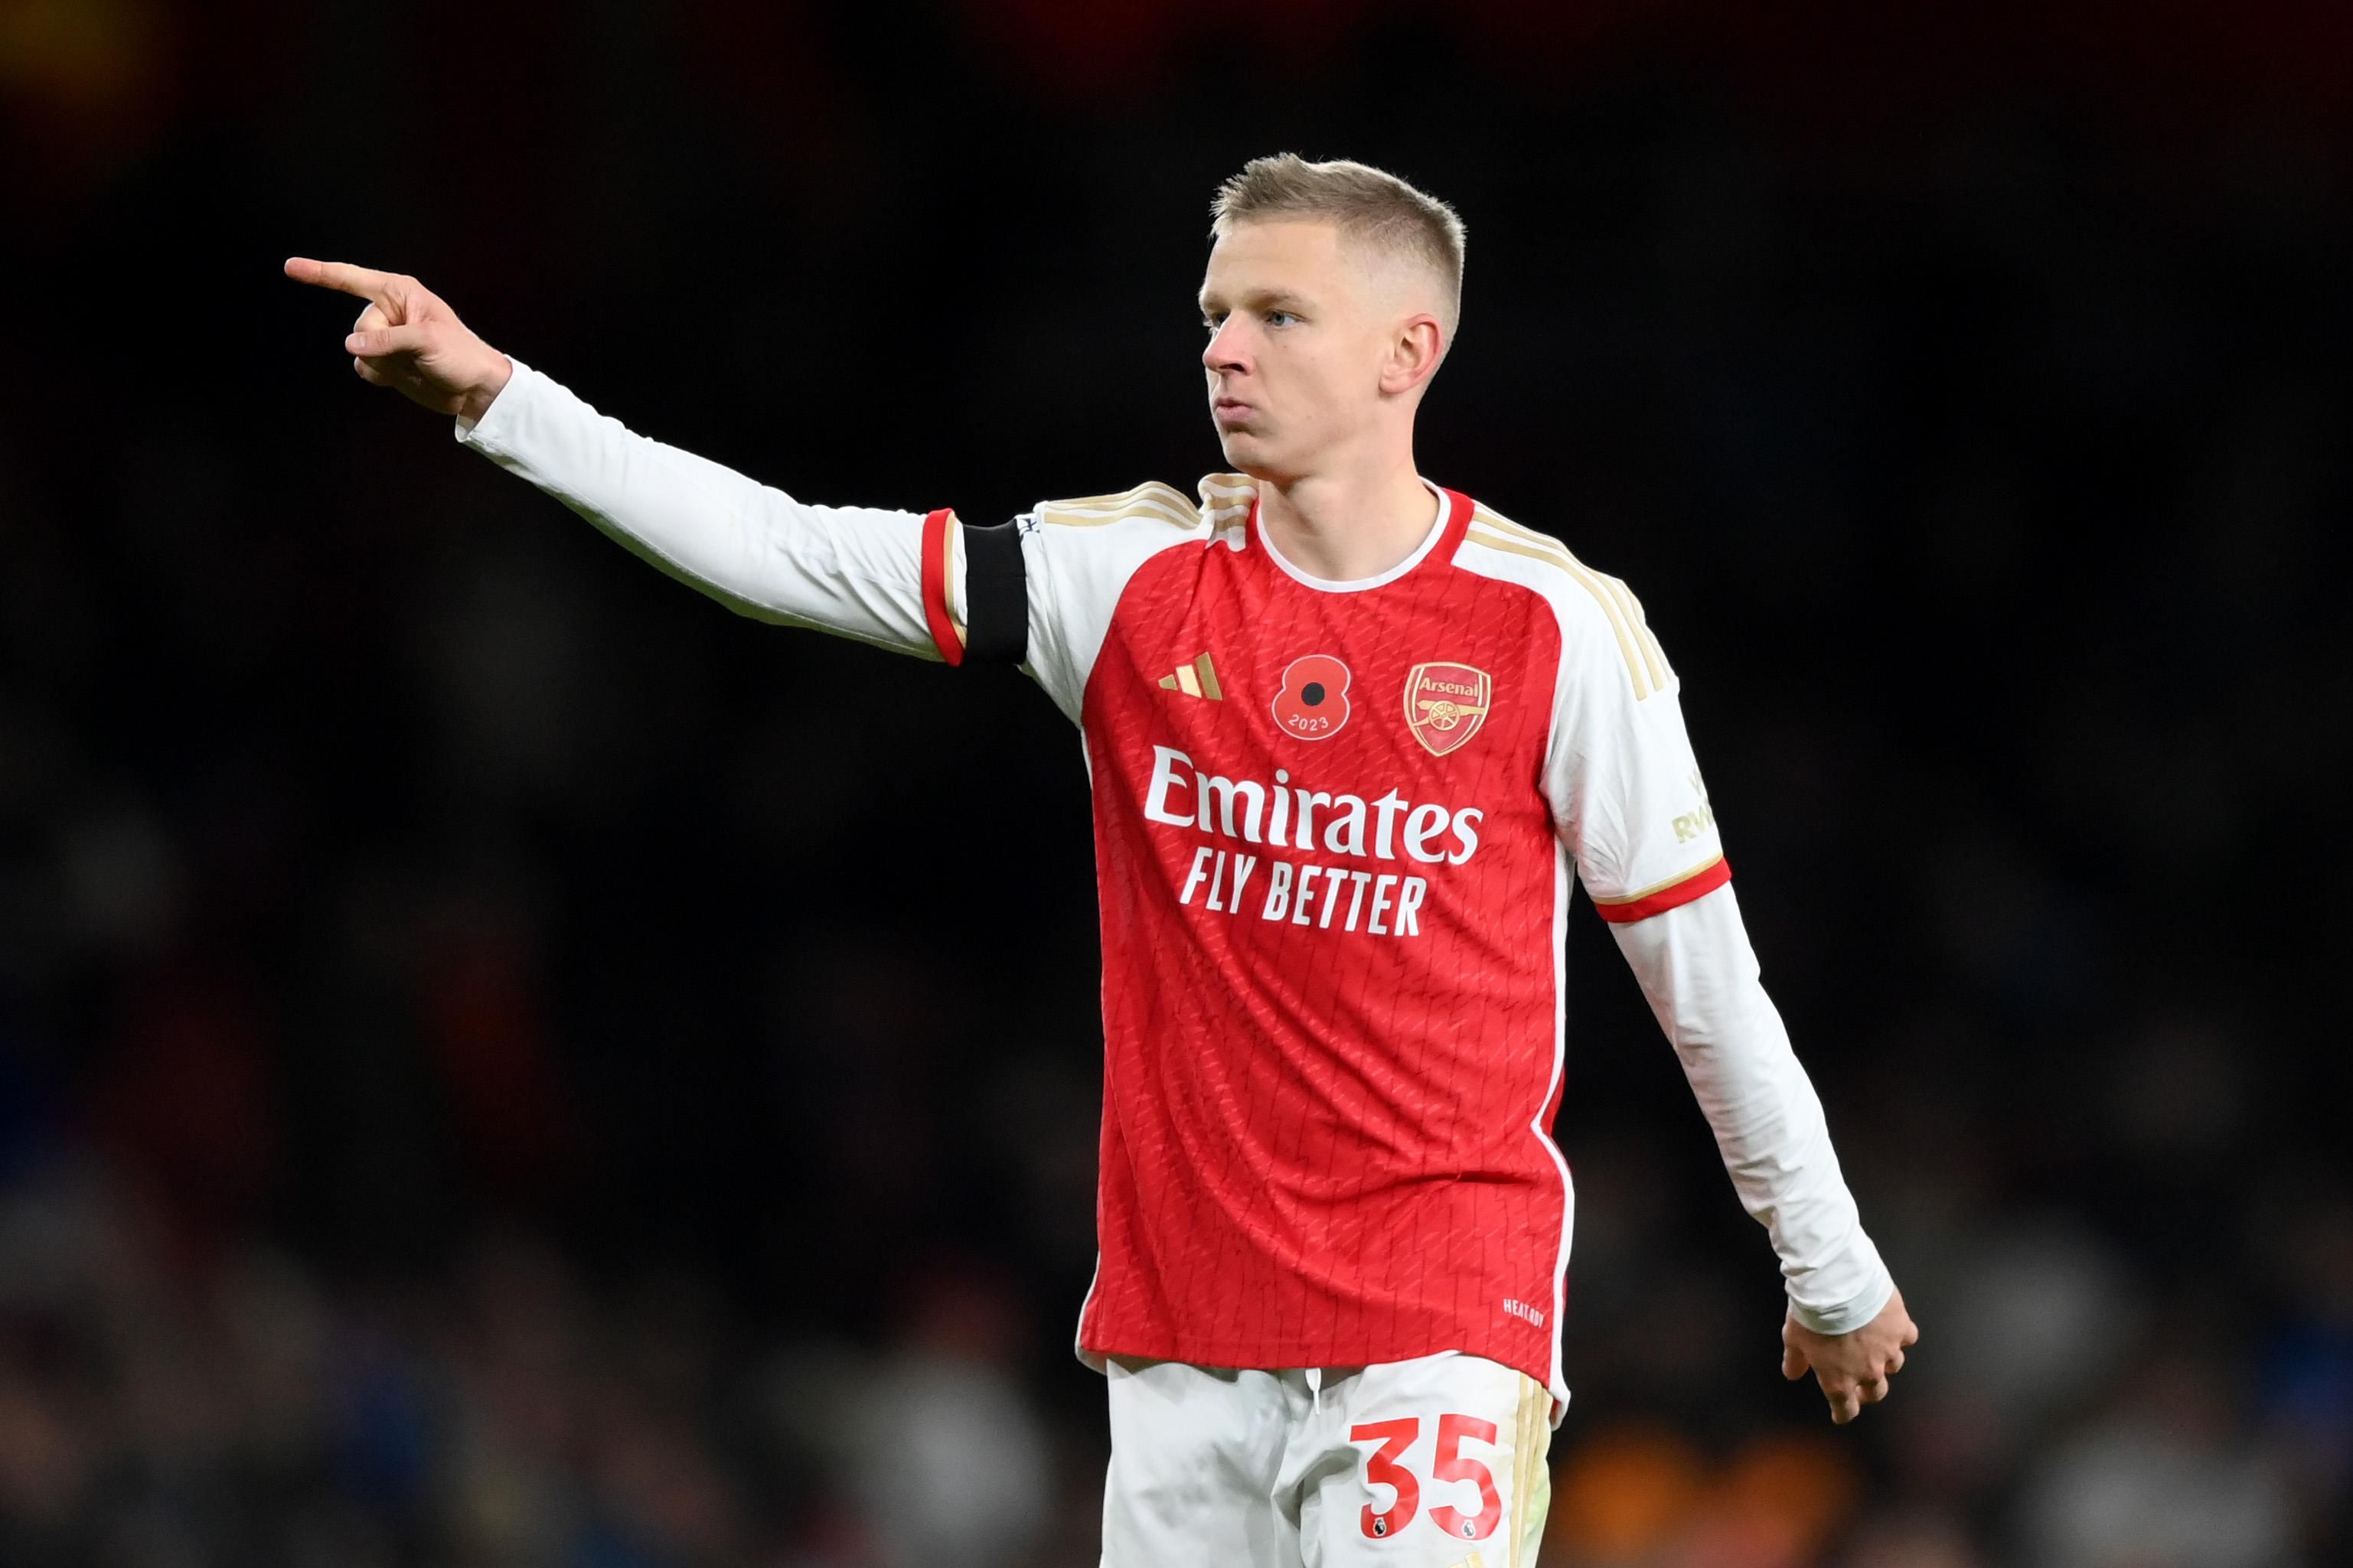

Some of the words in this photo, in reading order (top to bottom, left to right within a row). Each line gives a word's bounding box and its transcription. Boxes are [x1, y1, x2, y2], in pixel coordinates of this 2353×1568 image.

[1288, 714, 1329, 732] 2023
[1419, 677, 1479, 697] Arsenal
[1144, 745, 1483, 865] Emirates
[1180, 847, 1256, 914] FLY
[1262, 862, 1427, 937] BETTER
[1350, 1414, 1502, 1540] 35
